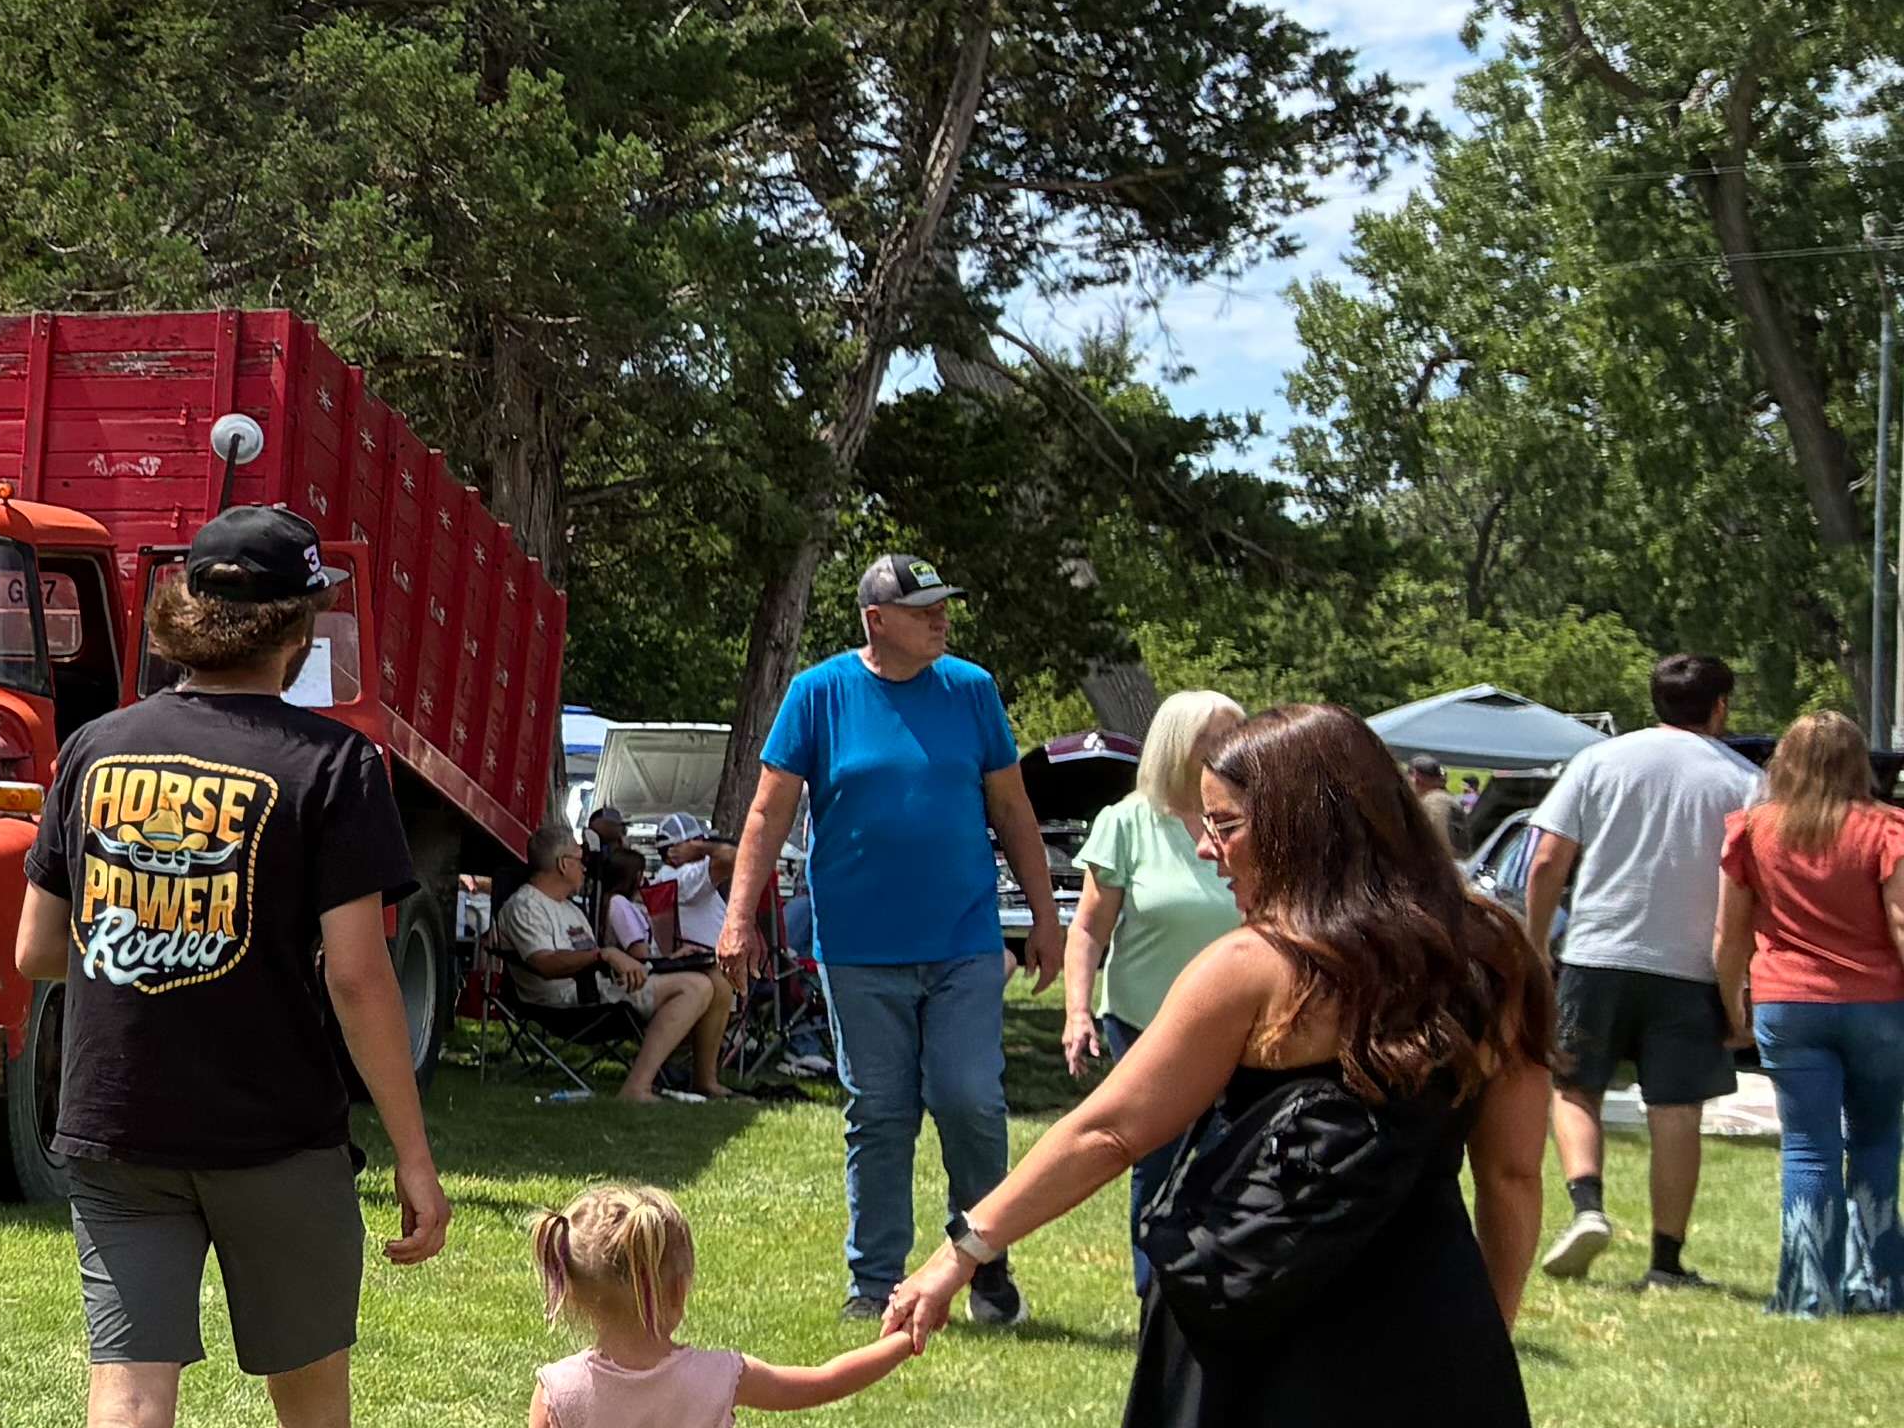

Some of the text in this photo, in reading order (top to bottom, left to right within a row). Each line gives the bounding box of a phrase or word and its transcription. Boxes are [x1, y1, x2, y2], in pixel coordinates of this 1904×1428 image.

[89, 766, 256, 843] HORSE
[81, 852, 239, 937] POWER
[83, 904, 239, 985] Rodeo
